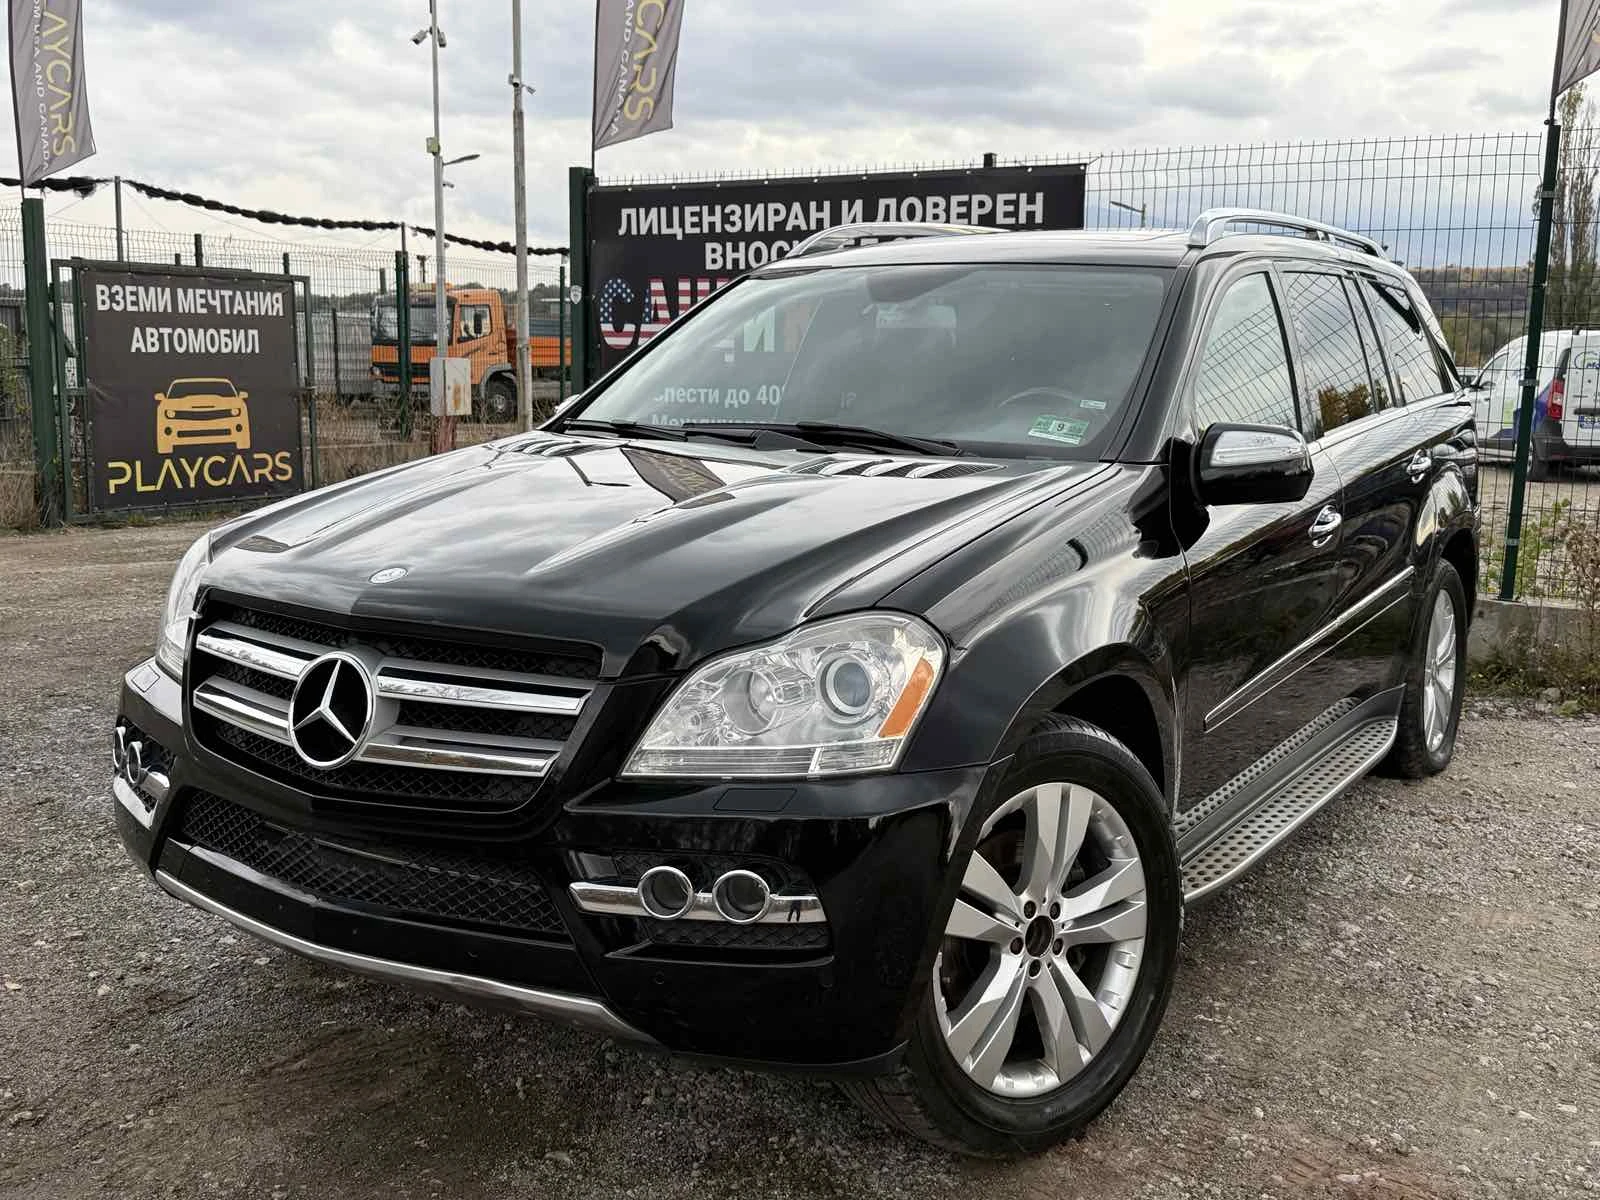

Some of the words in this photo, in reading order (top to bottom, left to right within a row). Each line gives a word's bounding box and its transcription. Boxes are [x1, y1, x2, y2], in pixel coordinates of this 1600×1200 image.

[34, 62, 45, 97] AND
[38, 103, 50, 170] CANADA
[618, 199, 831, 240] ЛИЦЕНЗИРАН
[841, 199, 864, 225] И
[875, 192, 1044, 226] ДОВЕРЕН
[95, 284, 172, 313] ВЗЕМИ
[177, 287, 285, 317] МЕЧТАНИЯ
[130, 327, 260, 354] АВТОМОБИЛ
[655, 387, 719, 405] пести
[725, 388, 749, 408] до
[756, 385, 785, 406] 40
[107, 451, 293, 494] PLAYCARS
